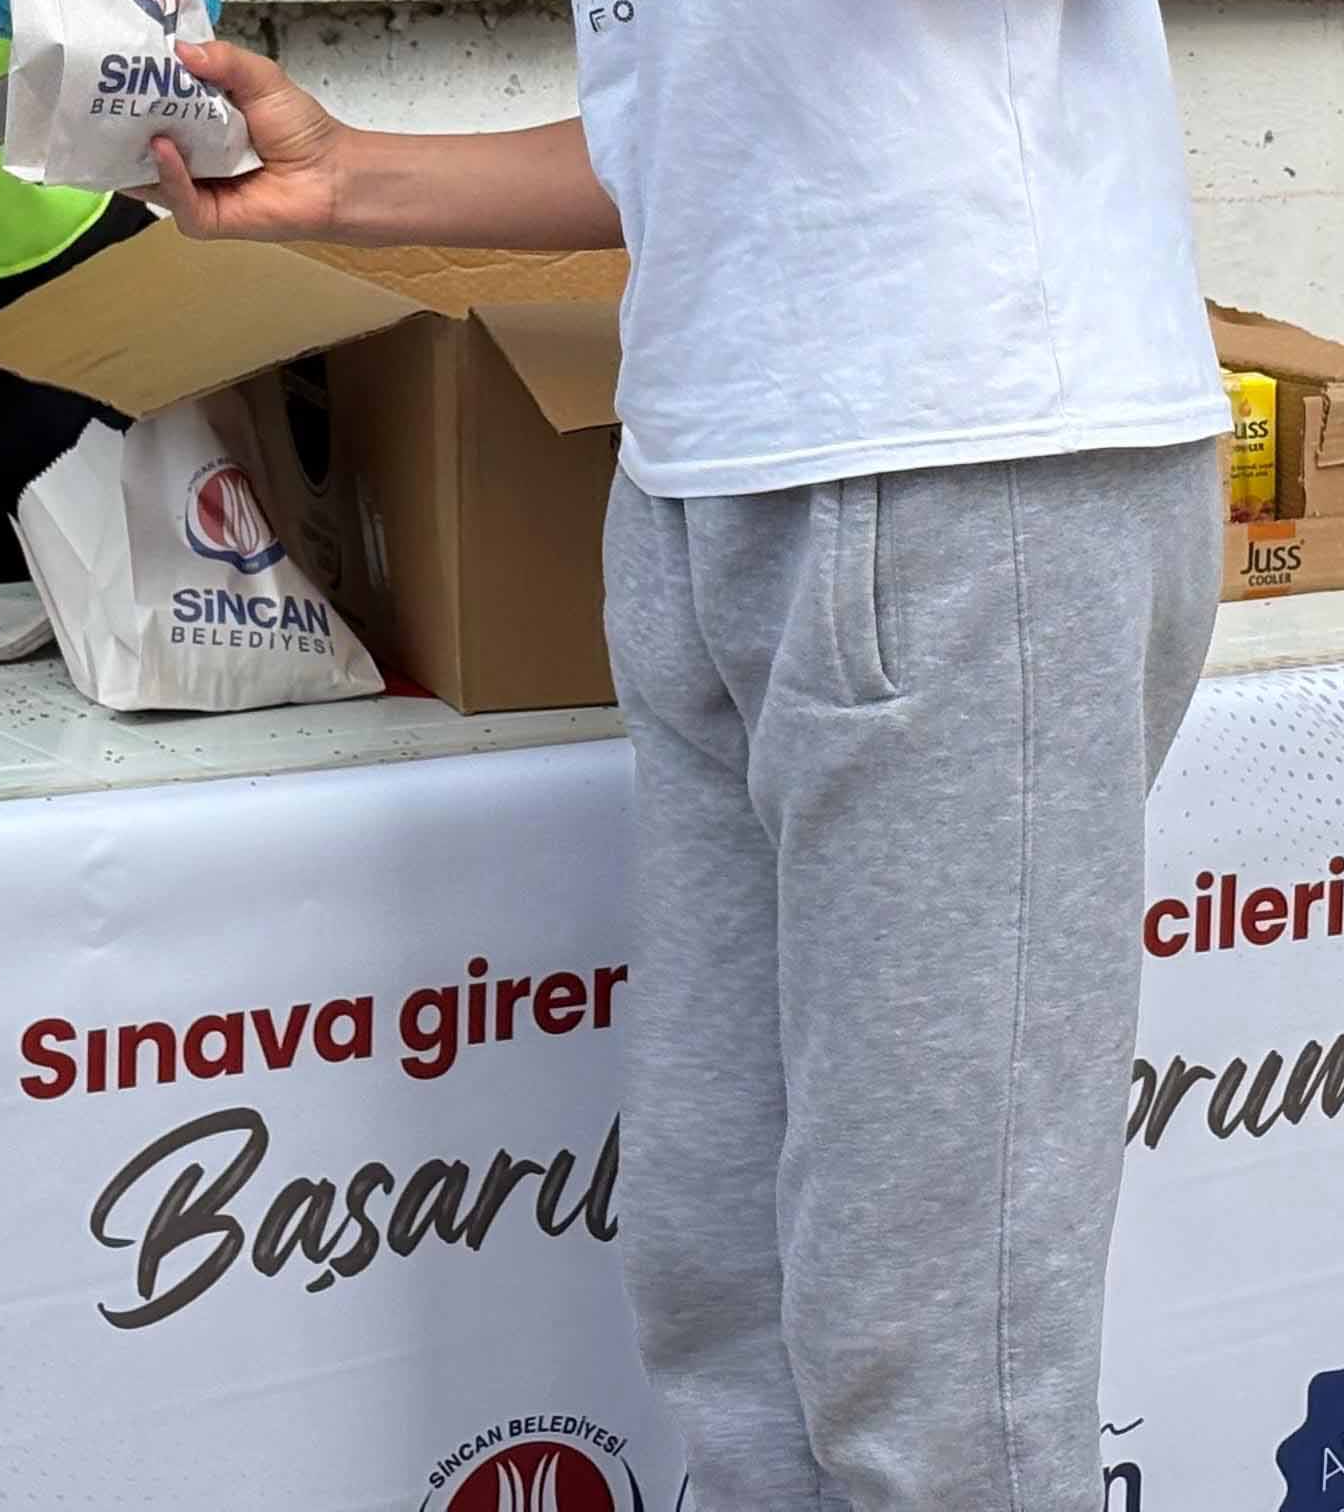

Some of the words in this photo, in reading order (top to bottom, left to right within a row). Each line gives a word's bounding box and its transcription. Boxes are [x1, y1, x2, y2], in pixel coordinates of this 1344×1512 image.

[1233, 419, 1269, 440] uss
[1240, 541, 1302, 575] Juss
[1248, 573, 1292, 587] COOLER
[20, 995, 374, 1100] Sınava
[89, 1106, 620, 1330] Başarıl
[429, 1426, 503, 1490] SİNCAN
[509, 1415, 628, 1457] BELEDİYESİ
